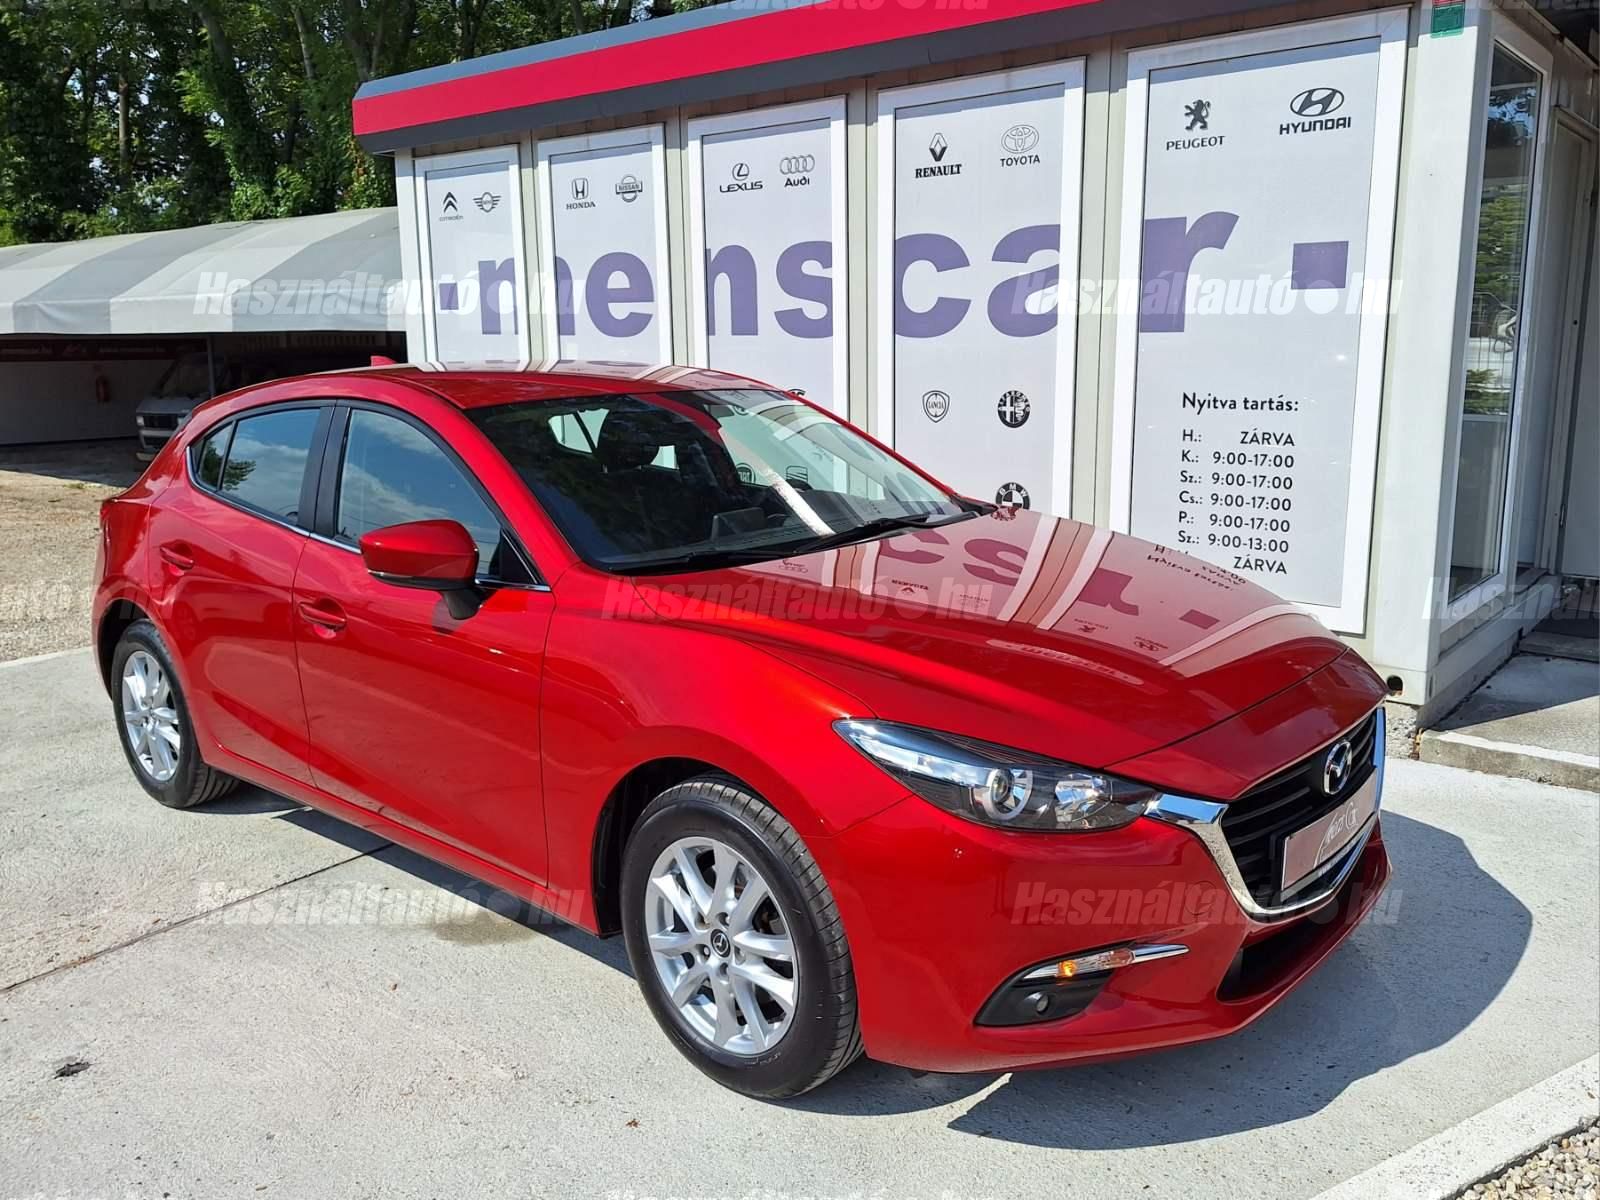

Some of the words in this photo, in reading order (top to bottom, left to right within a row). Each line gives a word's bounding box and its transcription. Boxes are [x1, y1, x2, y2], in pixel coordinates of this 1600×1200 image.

[1279, 116, 1351, 135] HYUNDAI
[1166, 135, 1226, 151] PEUGEOT
[1000, 154, 1041, 168] TOYOTA
[915, 163, 962, 179] RENAULT
[719, 181, 763, 193] LEXUS
[784, 176, 810, 188] Audi
[566, 200, 596, 210] HONDA
[1182, 392, 1237, 415] Nyitva
[1243, 394, 1298, 412] tartás:
[1182, 429, 1201, 442] H.:
[1240, 427, 1295, 446] ZÁRVA
[1181, 449, 1199, 463] K.:
[1212, 451, 1294, 468] 9:00-17:00
[1180, 470, 1201, 484] Sz.:
[1211, 472, 1293, 490] 9:00-17:00
[1179, 490, 1202, 505] Cs.:
[1210, 493, 1292, 511] 9:00-17:00
[1178, 511, 1194, 524] P.:
[1209, 514, 1290, 532] 9:00-17:00
[1178, 530, 1199, 544] Sz.:
[1208, 533, 1289, 553] 9:00-13:00
[1233, 553, 1288, 575] ZÁRVA
